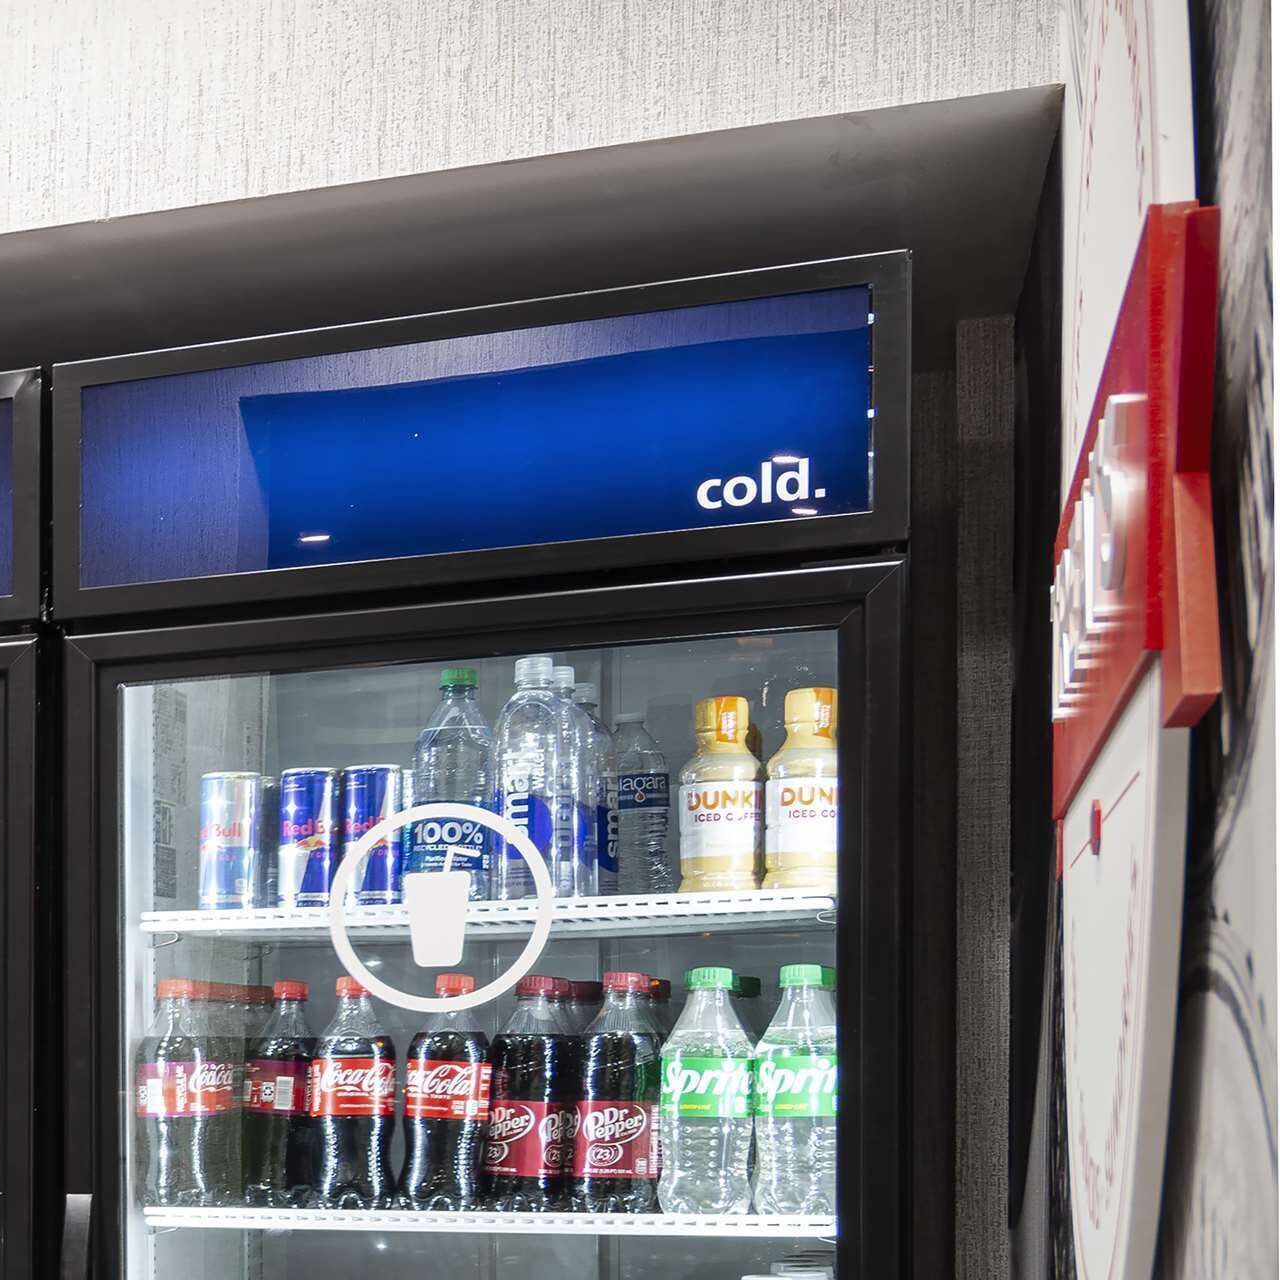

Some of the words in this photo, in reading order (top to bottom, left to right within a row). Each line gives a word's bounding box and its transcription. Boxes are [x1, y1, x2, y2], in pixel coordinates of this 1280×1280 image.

[697, 461, 827, 509] cold.
[694, 812, 720, 823] ICED
[788, 810, 815, 819] ICED
[283, 820, 312, 835] Red
[415, 822, 483, 843] 100%
[605, 1108, 627, 1124] Dr
[586, 1112, 639, 1141] Pepper
